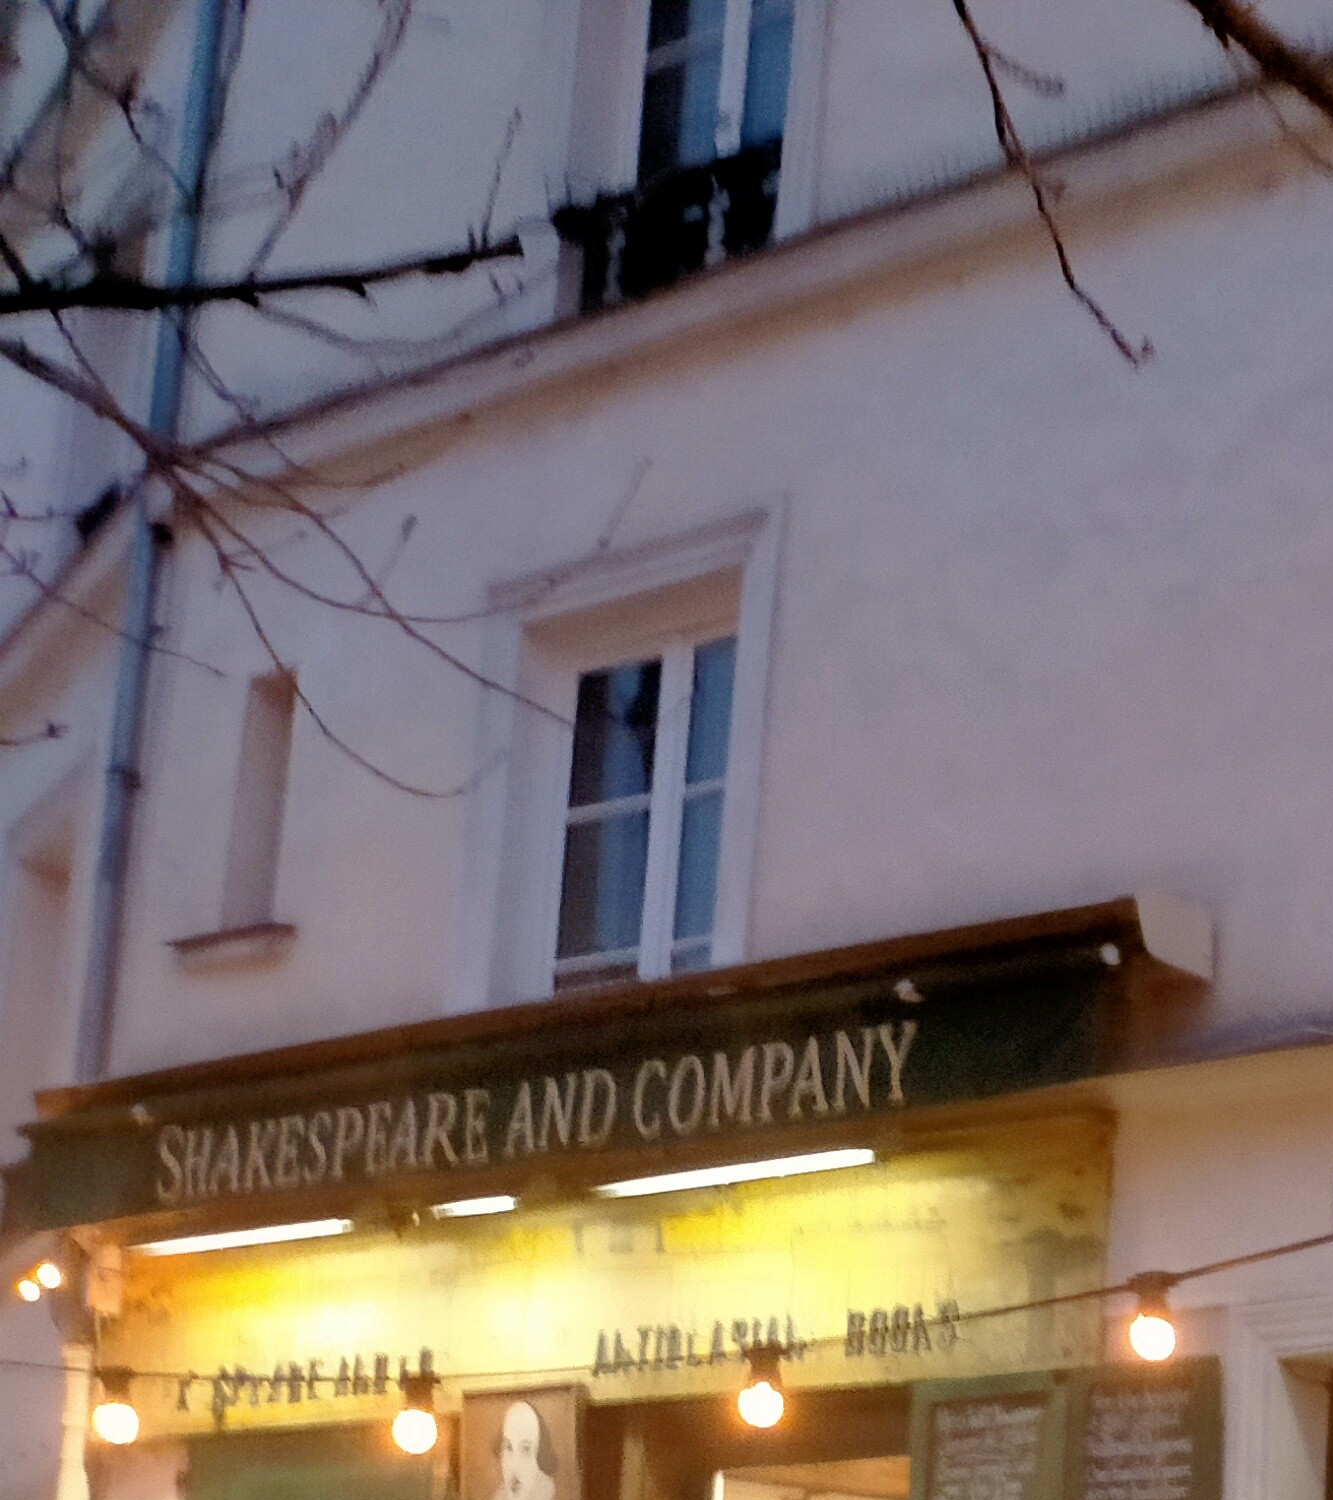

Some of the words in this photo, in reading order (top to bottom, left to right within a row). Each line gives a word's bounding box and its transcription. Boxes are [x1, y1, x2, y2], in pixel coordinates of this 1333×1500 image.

[155, 1087, 491, 1203] SHAKESPEARE
[503, 1068, 617, 1159] AND
[632, 1019, 919, 1142] COMPANY
